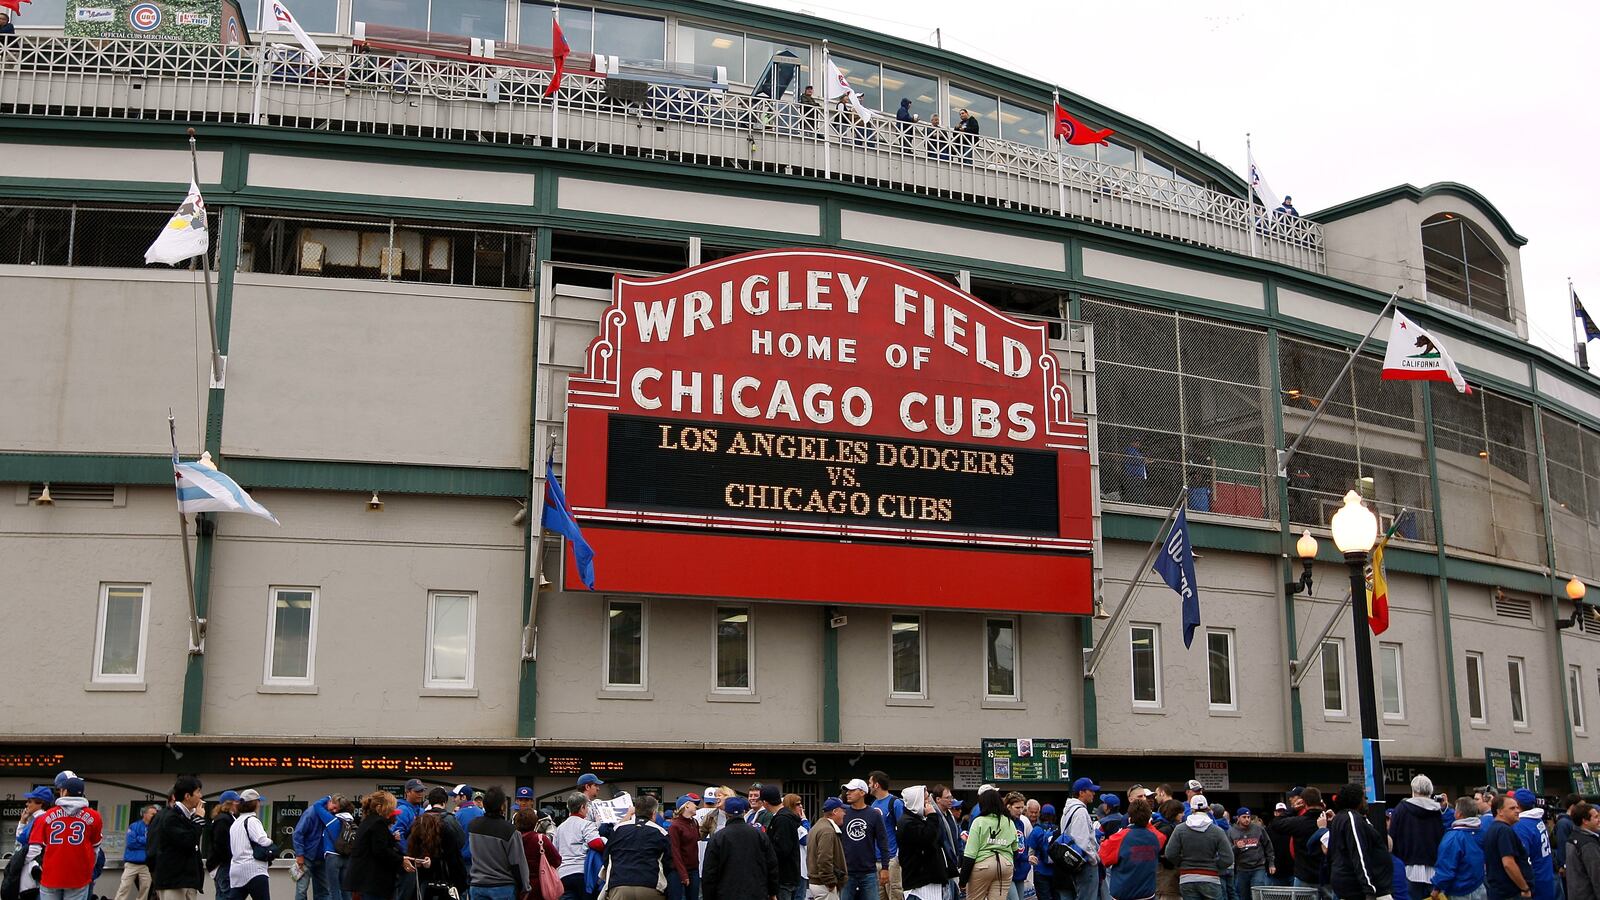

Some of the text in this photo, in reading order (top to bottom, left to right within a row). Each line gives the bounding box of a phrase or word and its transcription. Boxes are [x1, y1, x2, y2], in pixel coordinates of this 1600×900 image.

[634, 270, 1032, 379] WRIGLEY FIELD
[752, 329, 931, 370] HOME OF
[1402, 359, 1440, 368] CALIFORNIA
[631, 367, 1036, 442] CHICAGO CUBS
[658, 425, 1015, 476] LOS ANGELES DODGERS
[826, 466, 861, 488] VS.
[725, 483, 952, 522] CHICAGO CUBS
[802, 758, 817, 775] G
[1384, 767, 1404, 782] ATE
[7, 793, 16, 801] 21
[280, 808, 302, 817] CLOSED
[50, 820, 86, 845] 23
